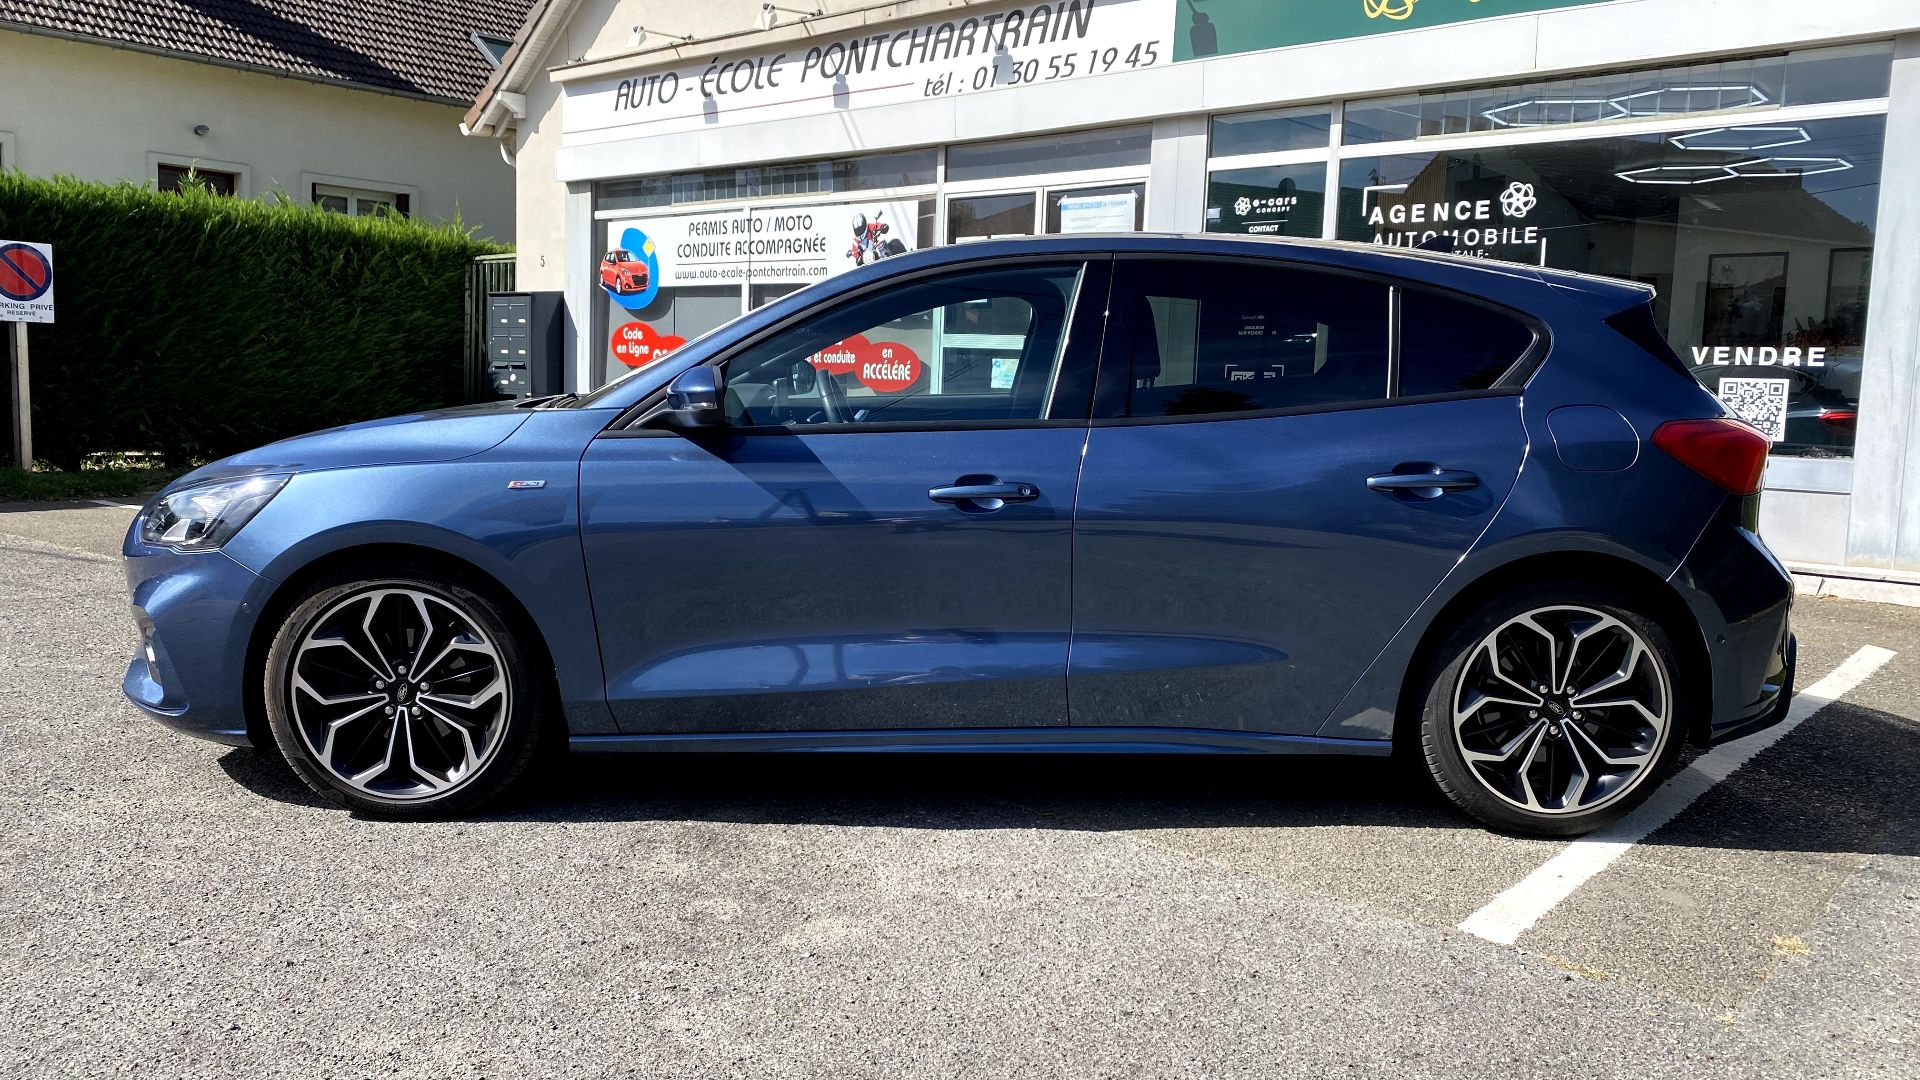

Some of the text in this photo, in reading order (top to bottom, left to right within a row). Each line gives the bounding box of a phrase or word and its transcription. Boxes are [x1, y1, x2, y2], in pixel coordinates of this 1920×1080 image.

[615, 71, 679, 111] AUTO
[700, 56, 786, 97] ÉCOLE
[801, 0, 1095, 83] PONTCHARTRAIN
[924, 72, 953, 97] tél
[973, 65, 998, 91] 01
[1008, 58, 1039, 86] 30
[1045, 53, 1077, 80] 55
[1089, 47, 1118, 74] 19
[1125, 40, 1160, 68] 45
[1252, 196, 1297, 207] e-cars
[1256, 206, 1290, 214] CONCEPT
[1368, 200, 1491, 225] AGENCE
[689, 220, 728, 236] PERMIS
[732, 218, 763, 234] AUTO
[775, 215, 813, 232] MOTO
[1248, 225, 1279, 233] CONTACT
[677, 234, 826, 258] CONDUITE ACCOMPAGNÉE
[540, 256, 546, 267] 5
[675, 264, 828, 280] www.auto-ecole-pontchartrain.com
[623, 327, 643, 339] Code
[617, 344, 626, 353] en
[629, 342, 649, 357] Ligne
[814, 351, 822, 363] et
[823, 350, 856, 364] conduite
[882, 348, 893, 359] en
[1691, 346, 1826, 367] VENDRE
[863, 360, 911, 380] ACCÉLÉRÉ
